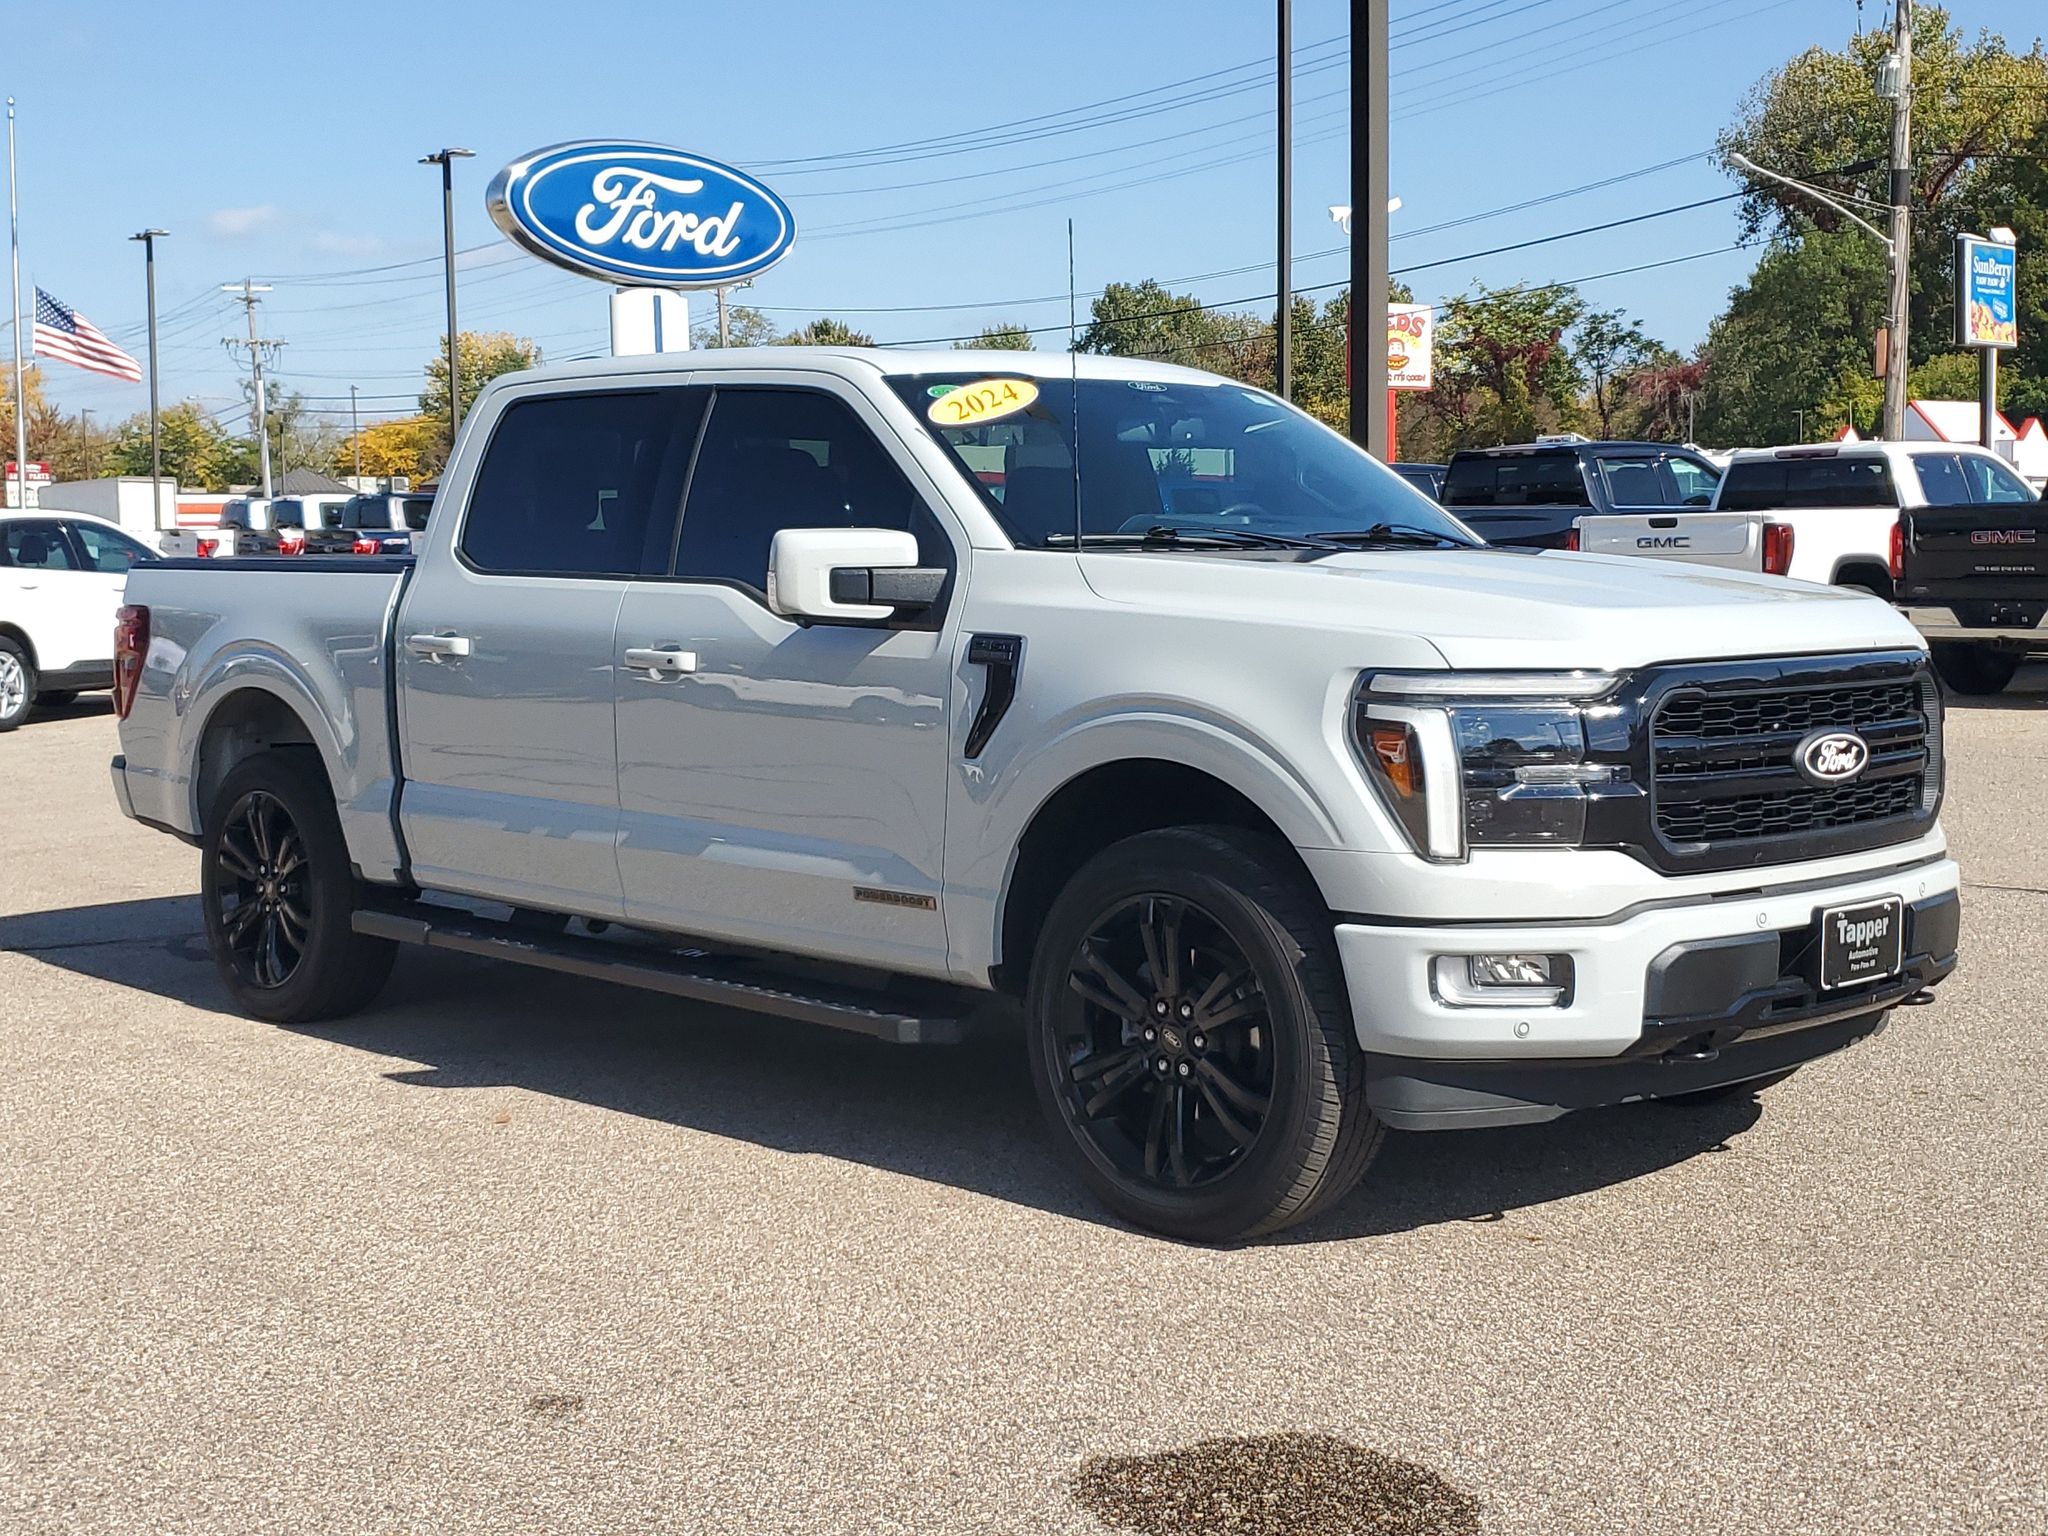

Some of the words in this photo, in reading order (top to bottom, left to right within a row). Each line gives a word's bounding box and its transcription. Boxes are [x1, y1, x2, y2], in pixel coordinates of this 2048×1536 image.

[575, 167, 744, 257] Ford
[1973, 256, 2012, 282] SunBerry
[948, 384, 1018, 420] 2024
[1636, 536, 1691, 549] GMC
[1971, 529, 2036, 544] GMC
[1817, 740, 1860, 773] Ford
[854, 889, 930, 908] POWERBOOST
[1837, 916, 1889, 948] Tapper
[1848, 946, 1880, 961] Automotive
